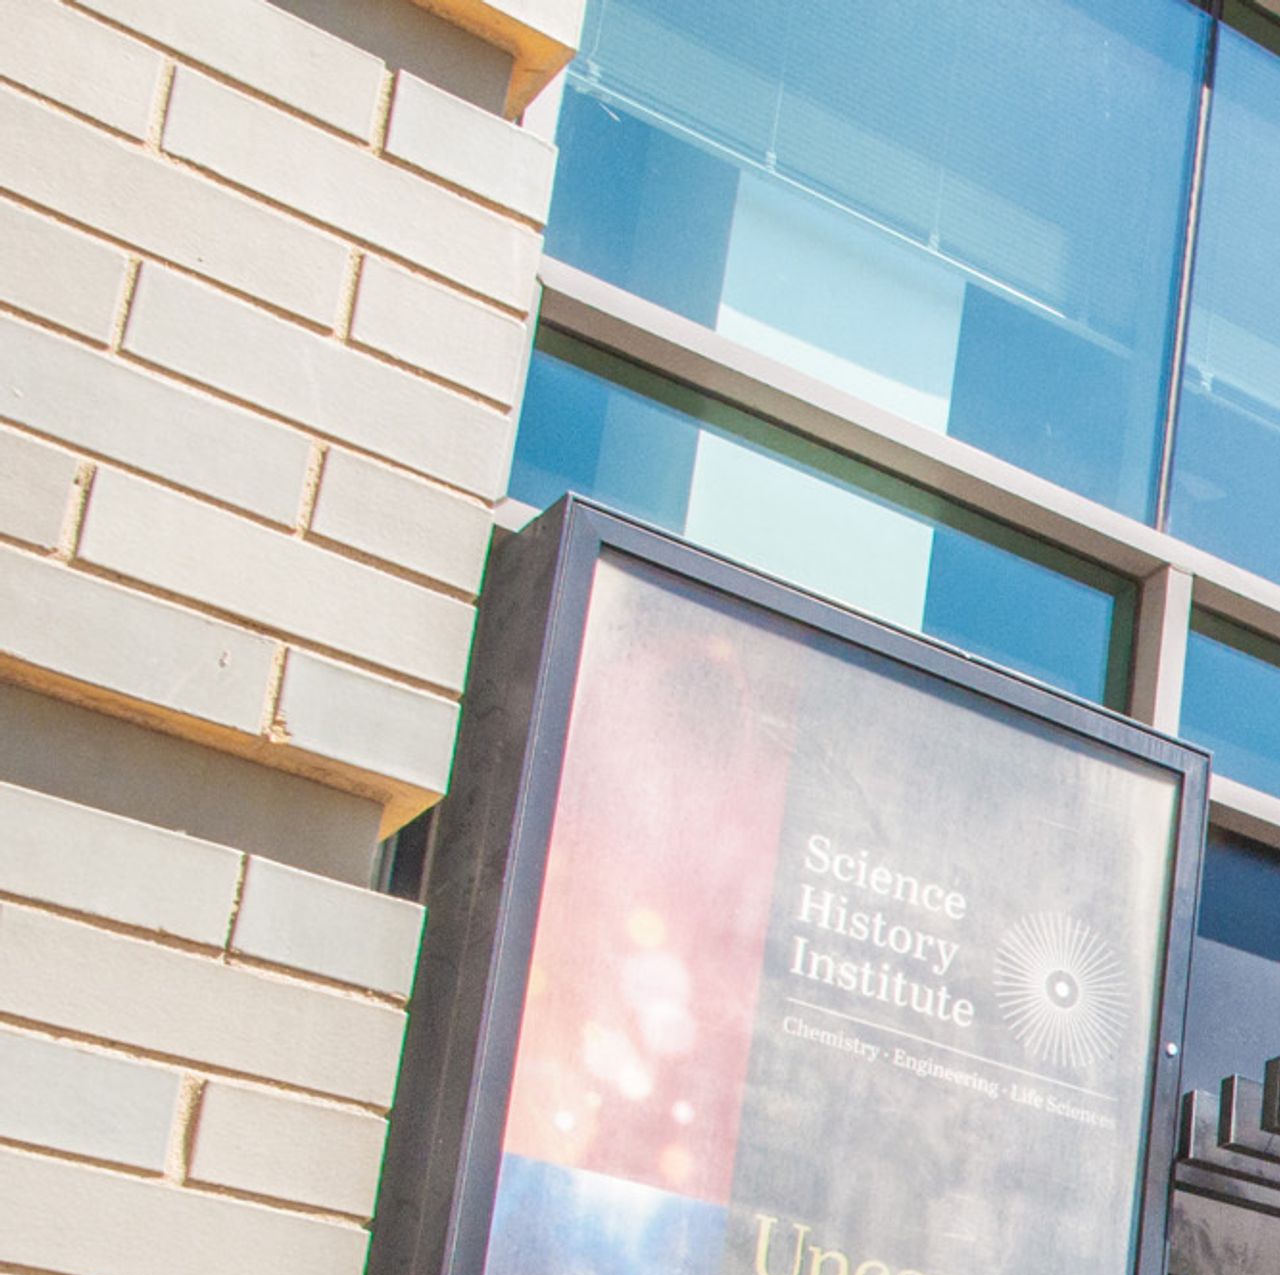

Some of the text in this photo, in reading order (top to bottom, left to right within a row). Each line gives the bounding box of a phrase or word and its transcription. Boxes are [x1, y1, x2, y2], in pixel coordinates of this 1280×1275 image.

[803, 832, 967, 920] Science
[797, 883, 961, 976] History
[788, 935, 976, 1028] Institute
[782, 1014, 1118, 1131] Chemistry Engineering Life Sciences
